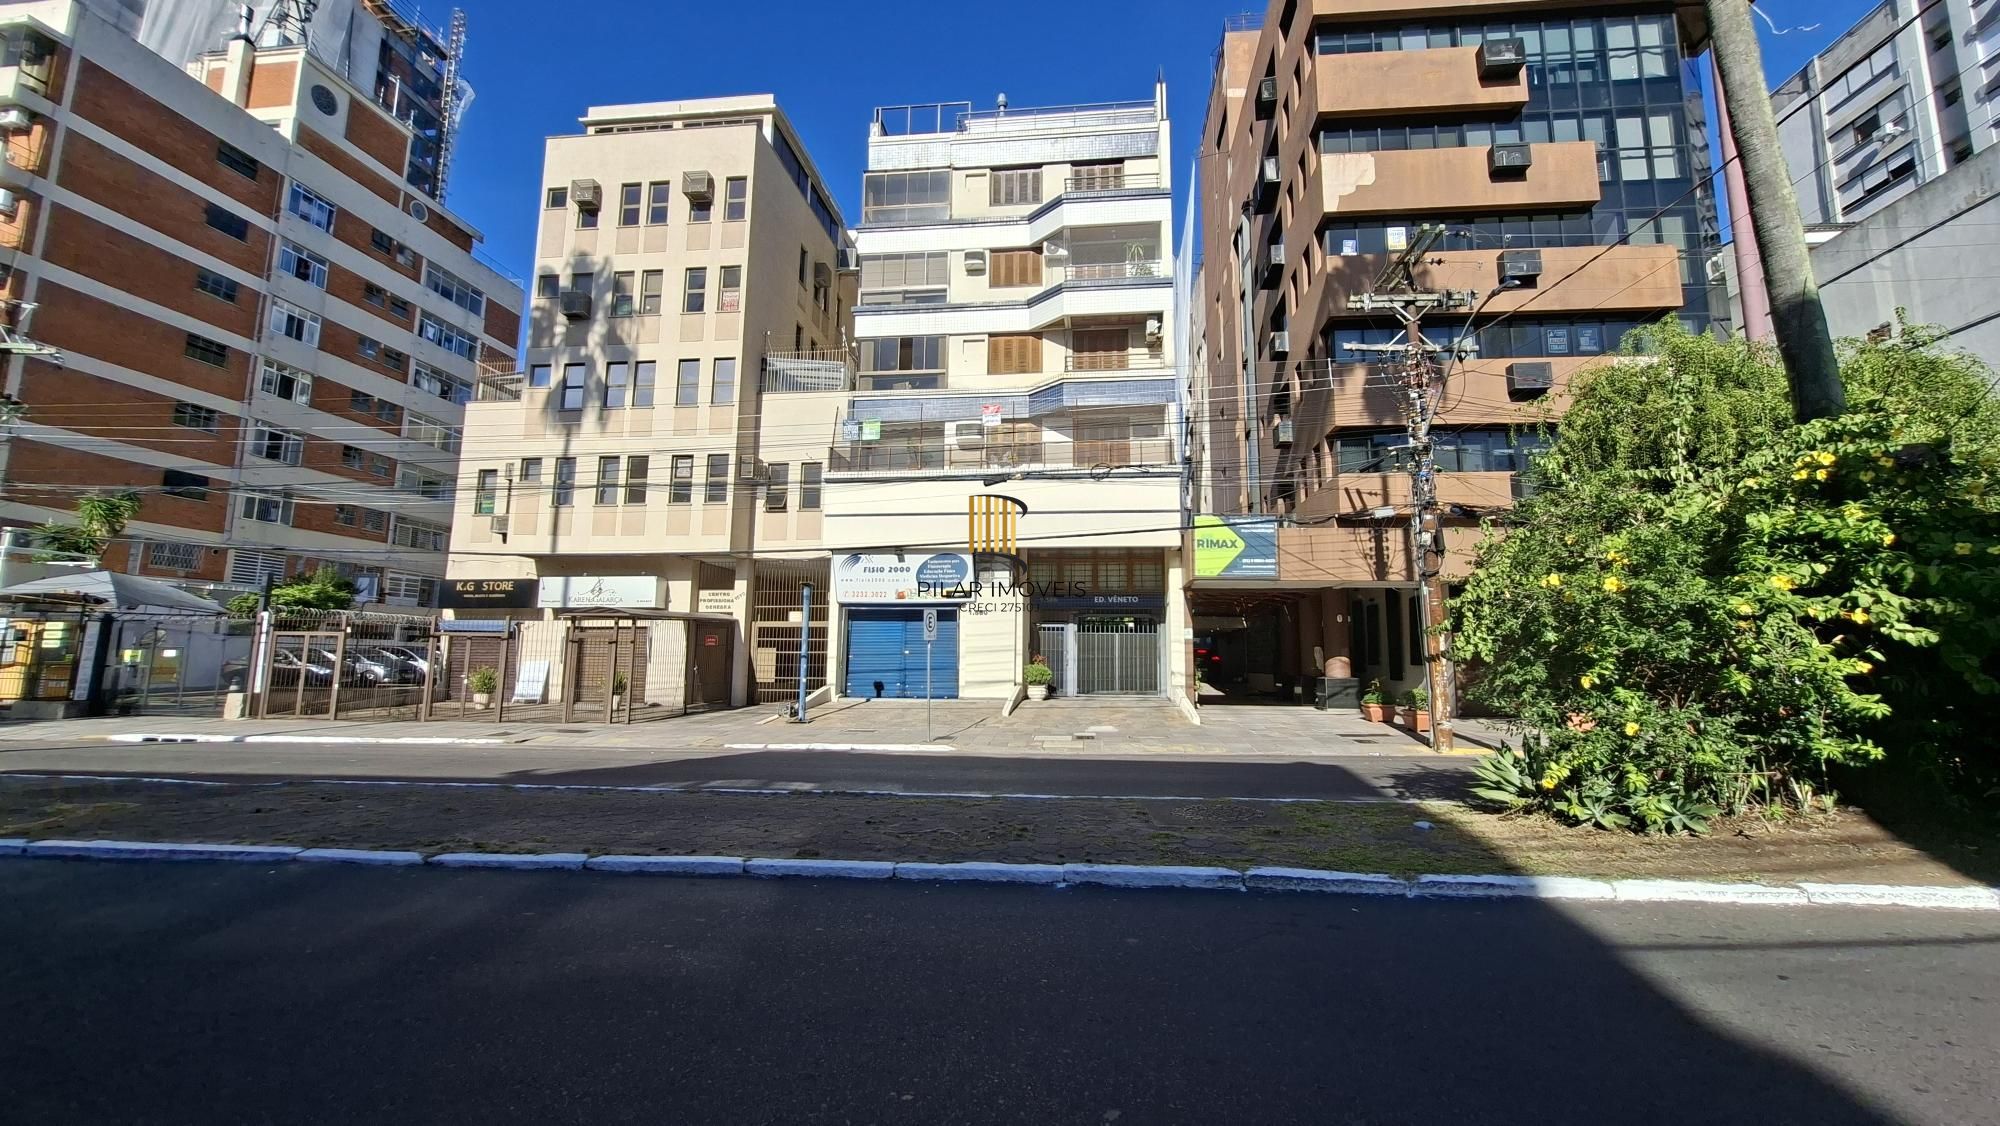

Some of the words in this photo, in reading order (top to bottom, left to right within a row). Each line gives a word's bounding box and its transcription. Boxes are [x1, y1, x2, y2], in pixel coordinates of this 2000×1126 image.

[1196, 538, 1238, 549] RIMAX
[863, 566, 885, 574] FISIO
[456, 581, 475, 591] K.G
[481, 581, 515, 591] STORE
[1107, 594, 1139, 603] VÊNETO
